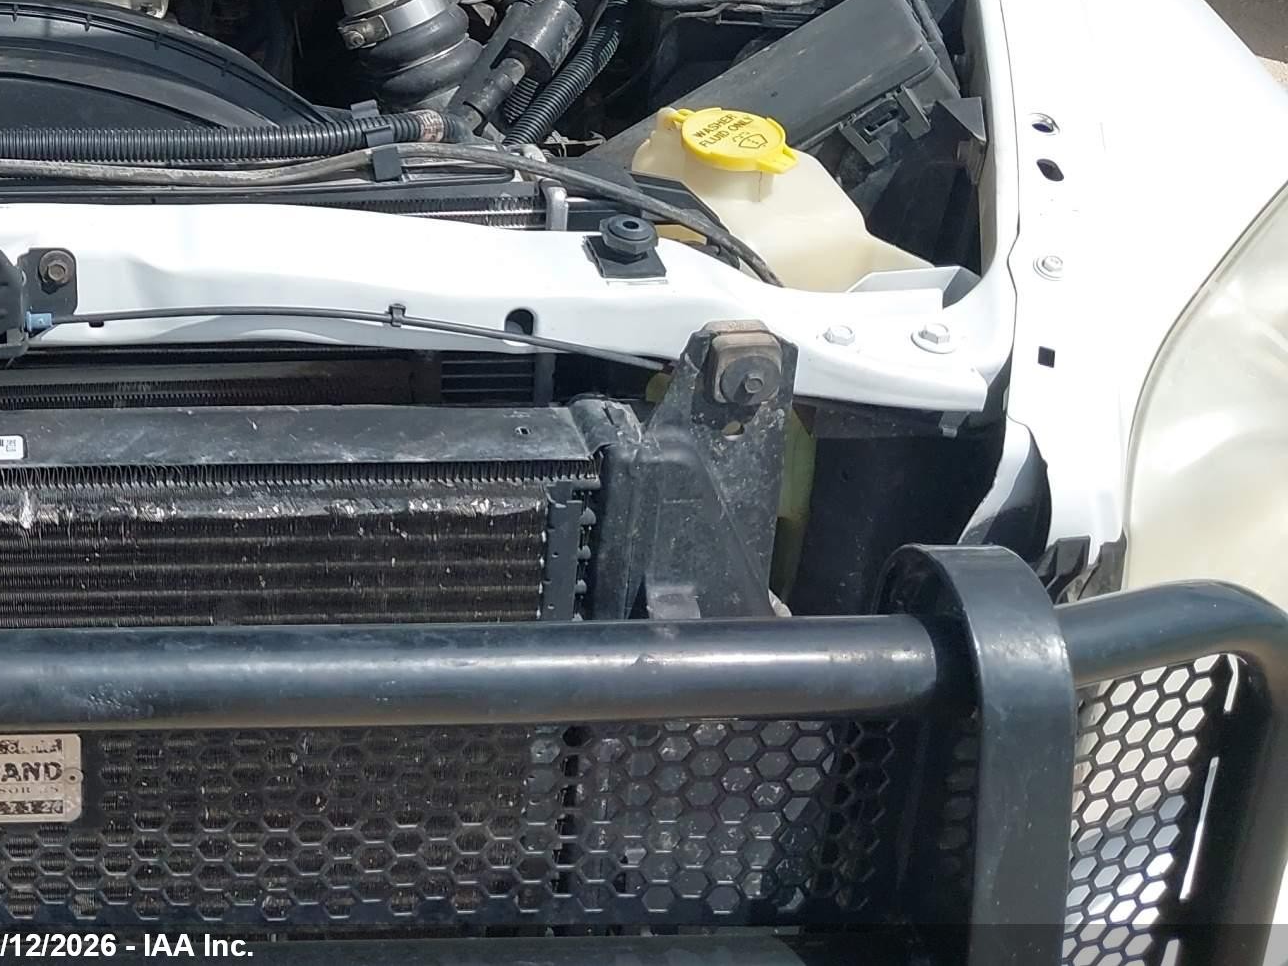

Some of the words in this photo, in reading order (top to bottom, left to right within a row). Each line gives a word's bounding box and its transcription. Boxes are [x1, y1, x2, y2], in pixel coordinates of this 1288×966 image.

[693, 113, 737, 138] WASHER
[699, 130, 730, 147] FLUID
[727, 114, 754, 132] ONLY
